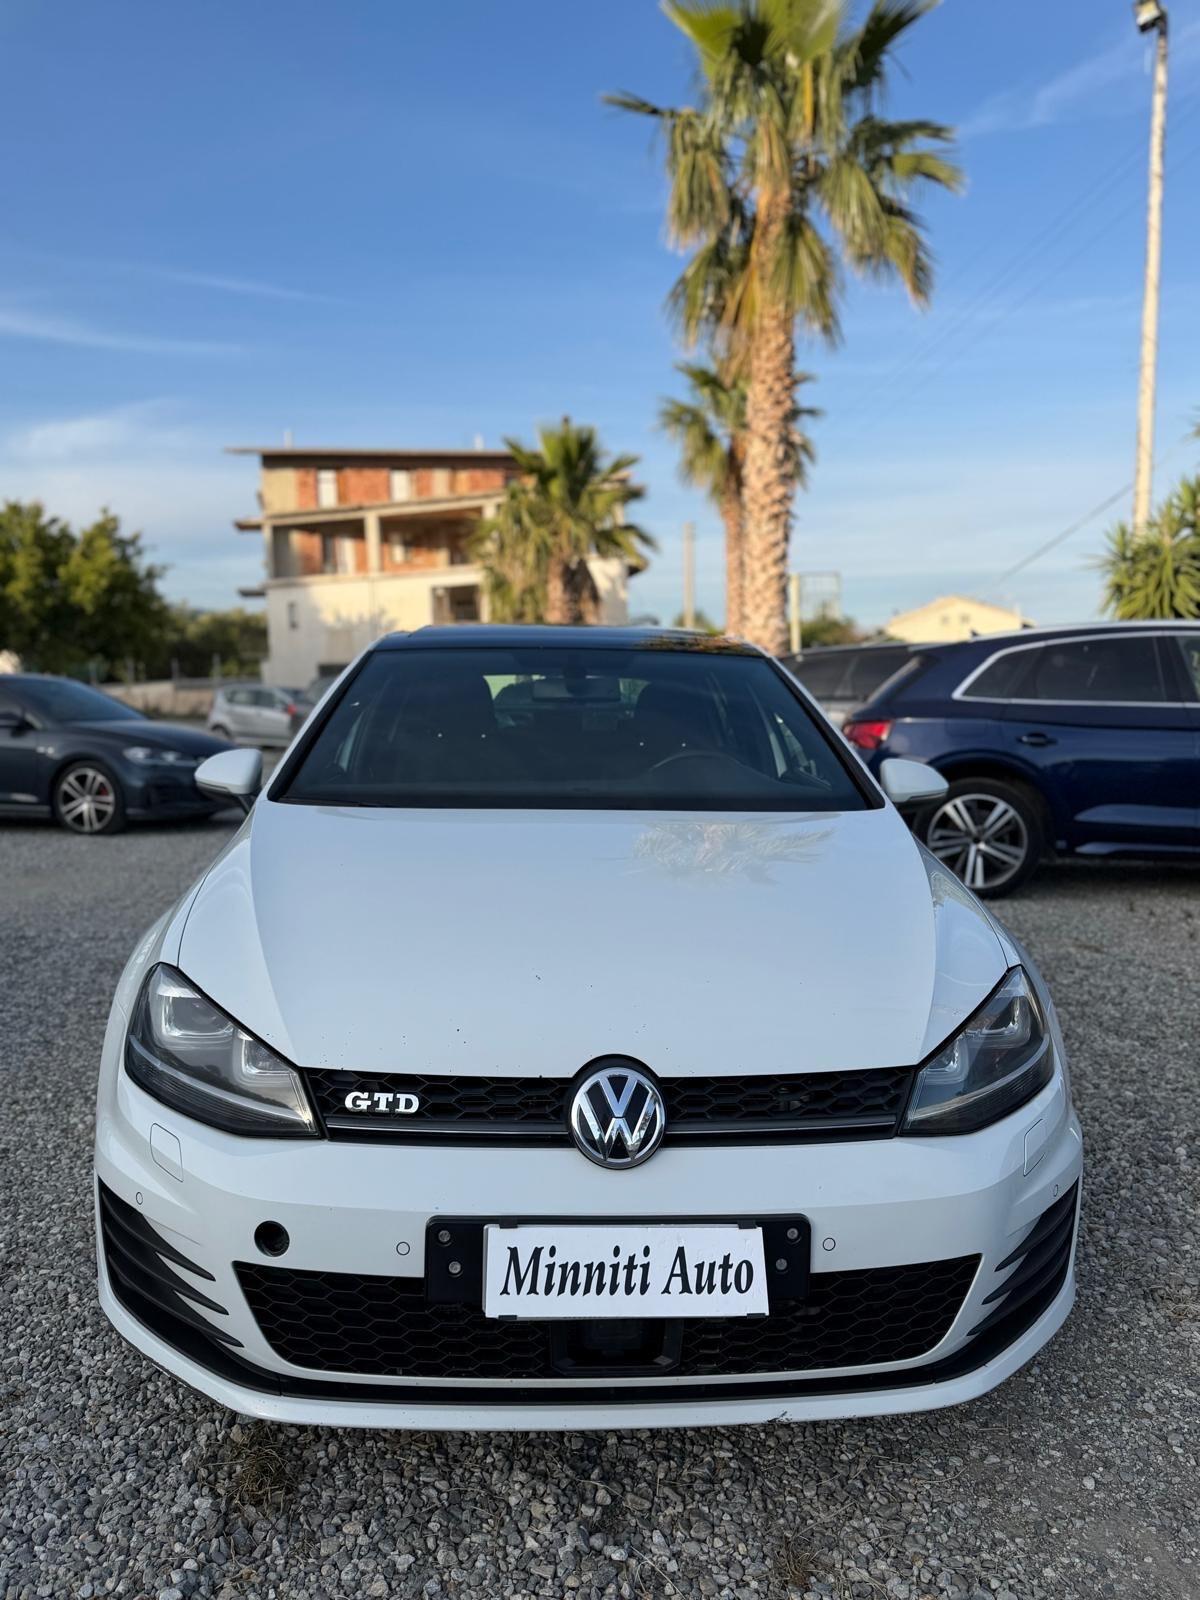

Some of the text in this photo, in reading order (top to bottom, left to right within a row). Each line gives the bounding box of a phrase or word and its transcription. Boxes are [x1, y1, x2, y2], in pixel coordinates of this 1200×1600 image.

[344, 1091, 420, 1114] GTD
[500, 1245, 754, 1297] Minniti Auto
